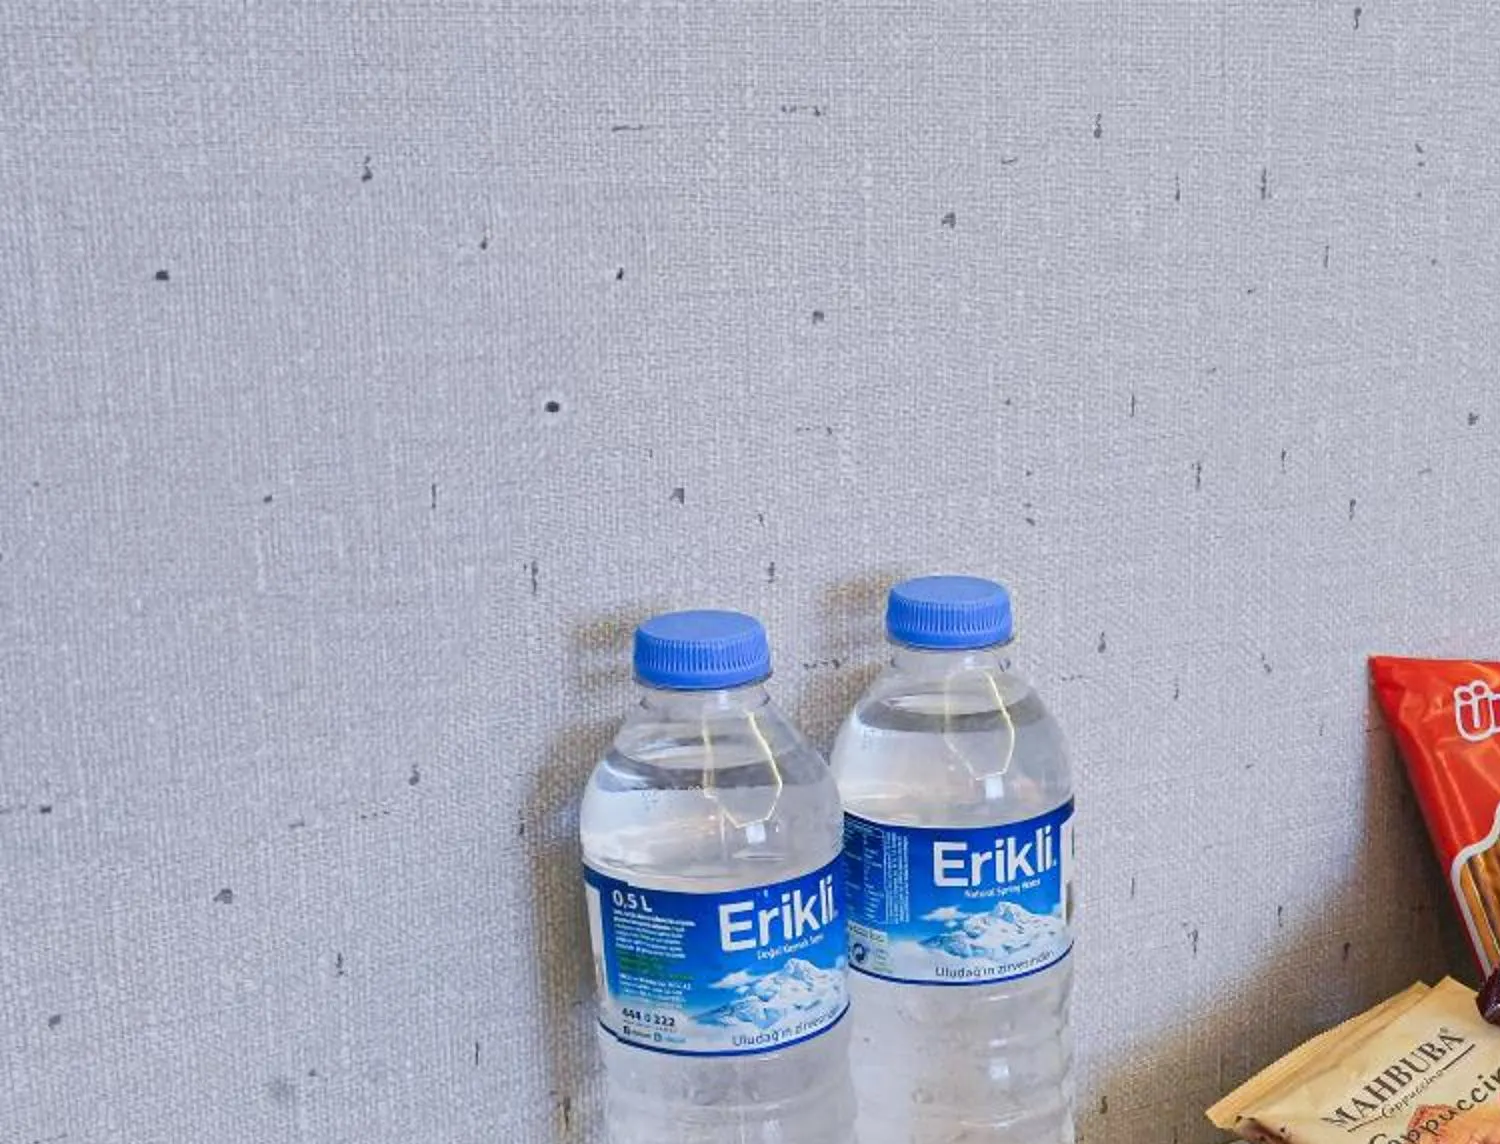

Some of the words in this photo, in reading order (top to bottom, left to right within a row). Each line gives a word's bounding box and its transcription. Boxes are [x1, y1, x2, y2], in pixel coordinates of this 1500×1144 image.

[933, 825, 1052, 888] Erikli
[641, 895, 653, 913] L
[718, 873, 834, 953] Erikli
[1321, 1032, 1464, 1129] MAHBUBA
[1381, 1069, 1443, 1119] Cappuccino
